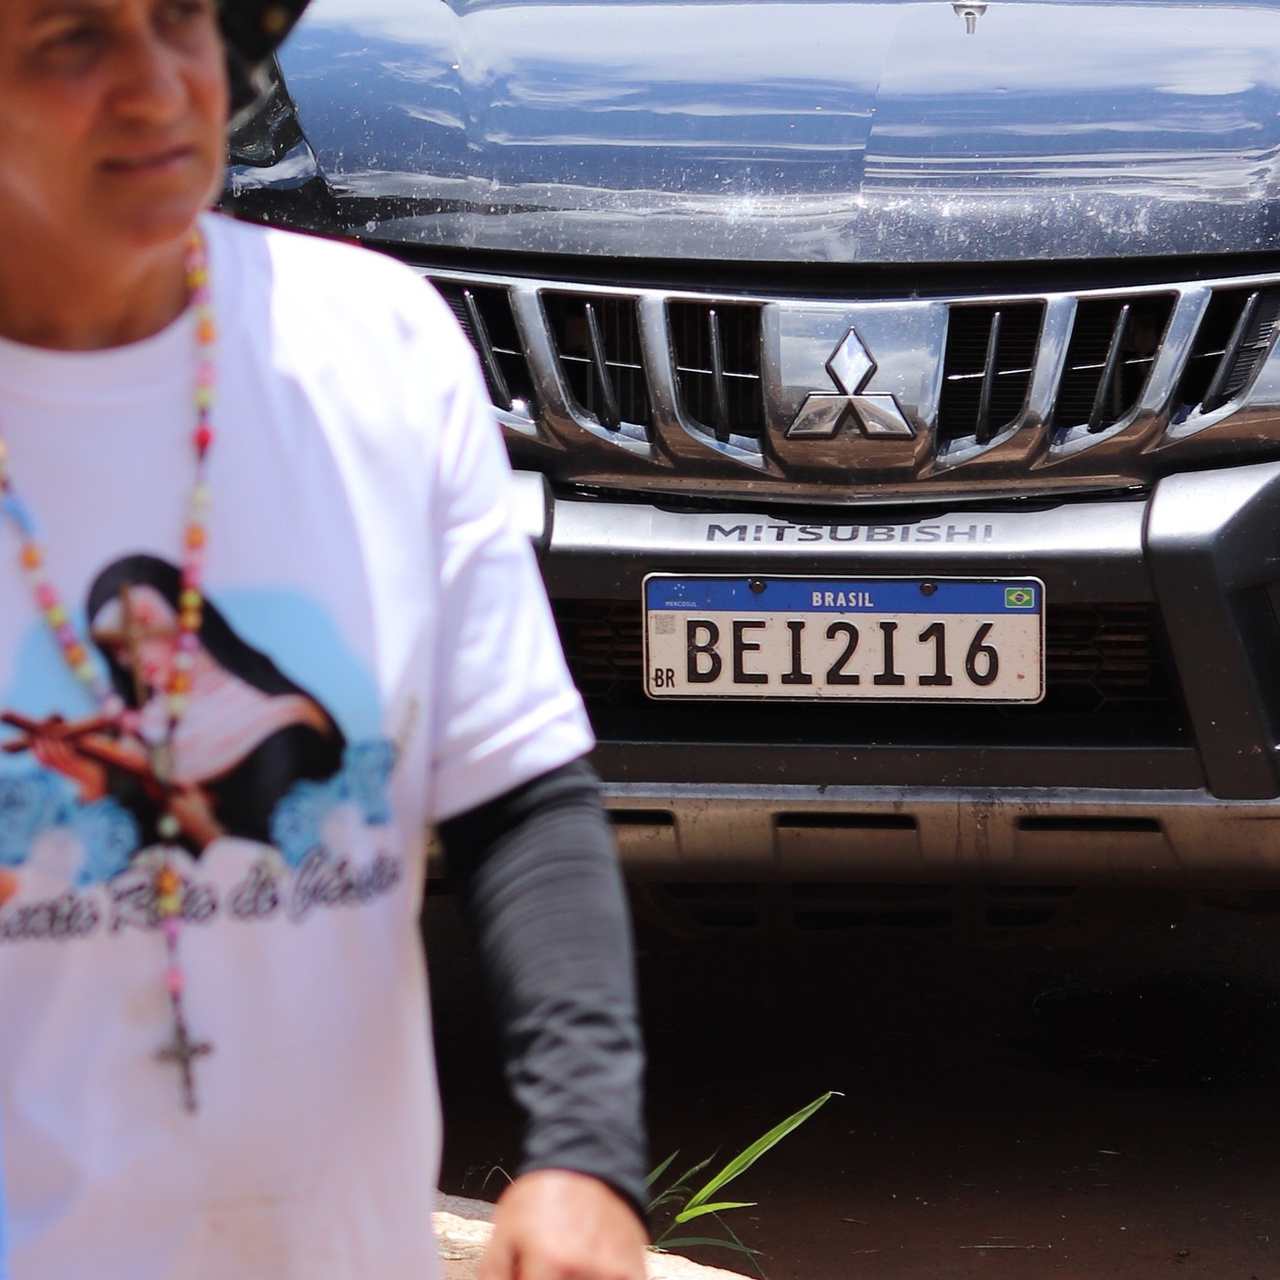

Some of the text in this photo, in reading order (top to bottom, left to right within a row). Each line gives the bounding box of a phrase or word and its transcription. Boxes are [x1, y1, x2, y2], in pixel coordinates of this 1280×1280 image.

[706, 524, 993, 543] MITSUBISHI
[812, 592, 874, 608] BRASIL
[686, 619, 1000, 687] BEI2I16
[655, 669, 676, 688] BR
[109, 877, 219, 935] Ra
